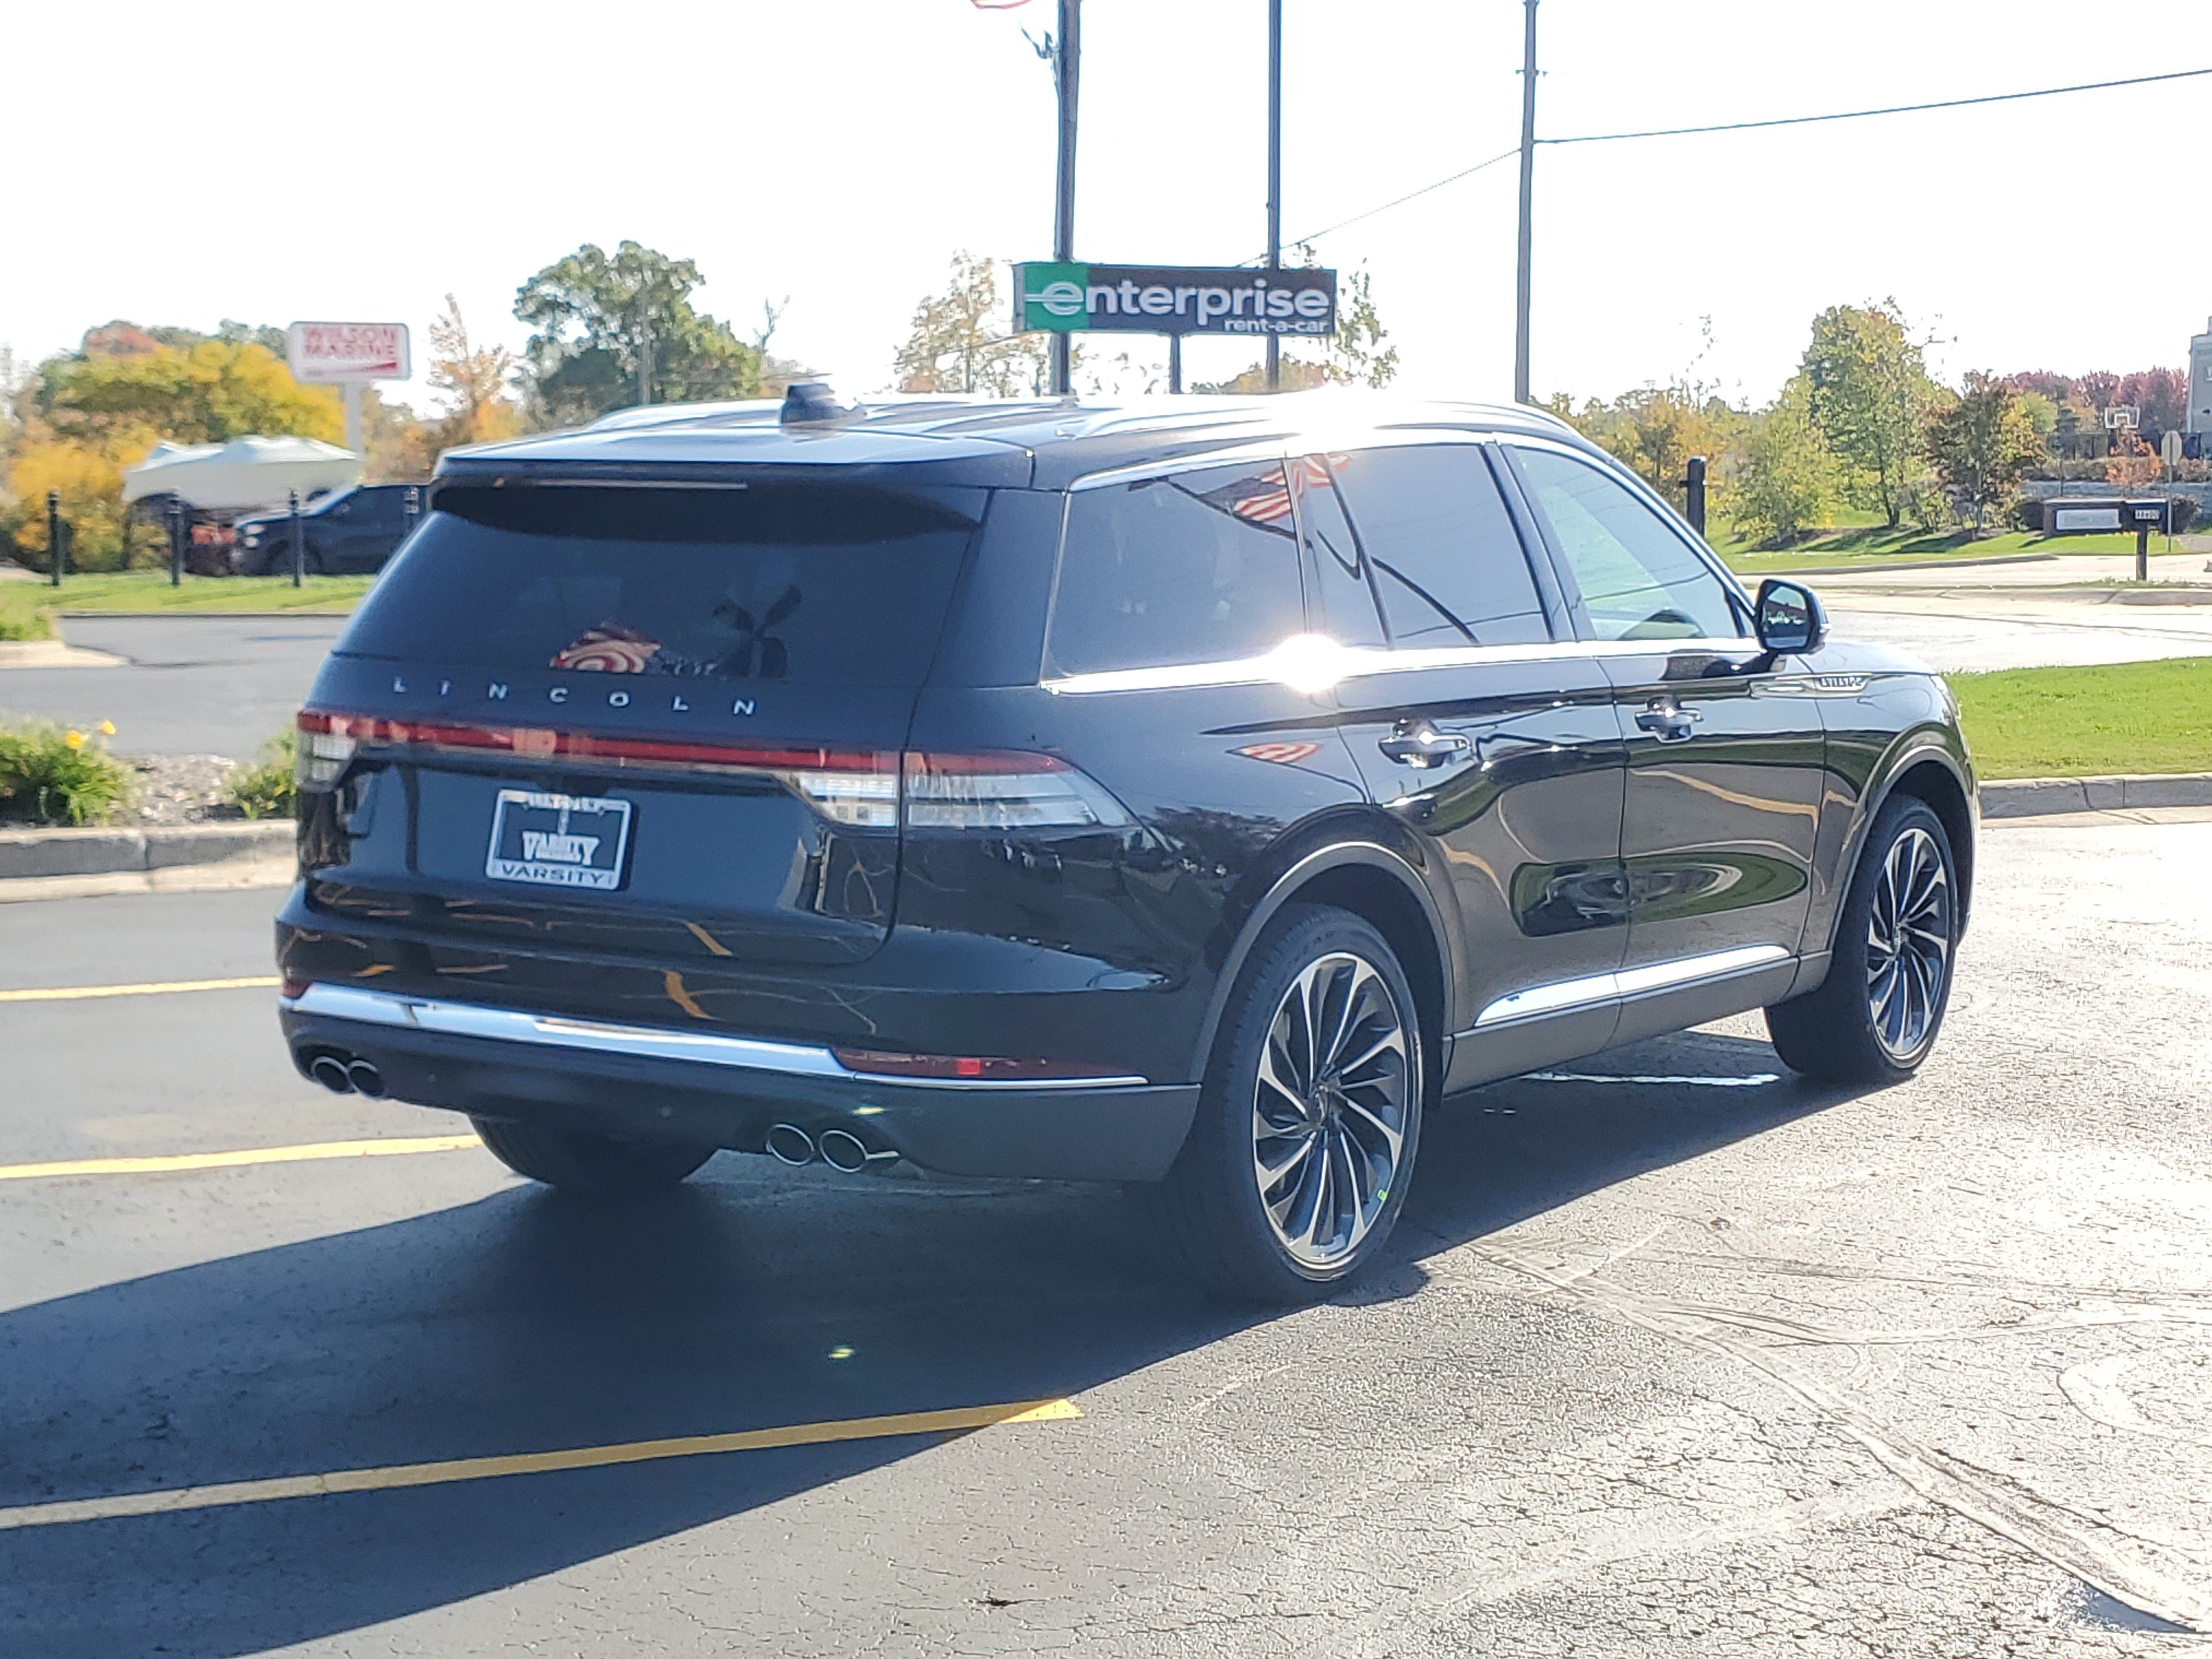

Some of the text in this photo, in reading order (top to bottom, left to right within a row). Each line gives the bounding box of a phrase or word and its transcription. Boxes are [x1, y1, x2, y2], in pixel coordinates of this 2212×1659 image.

[1025, 279, 1329, 326] enterprise
[1224, 318, 1329, 333] rent-a-car
[393, 676, 755, 716] LINCOLN
[501, 864, 603, 884] VARSITY
